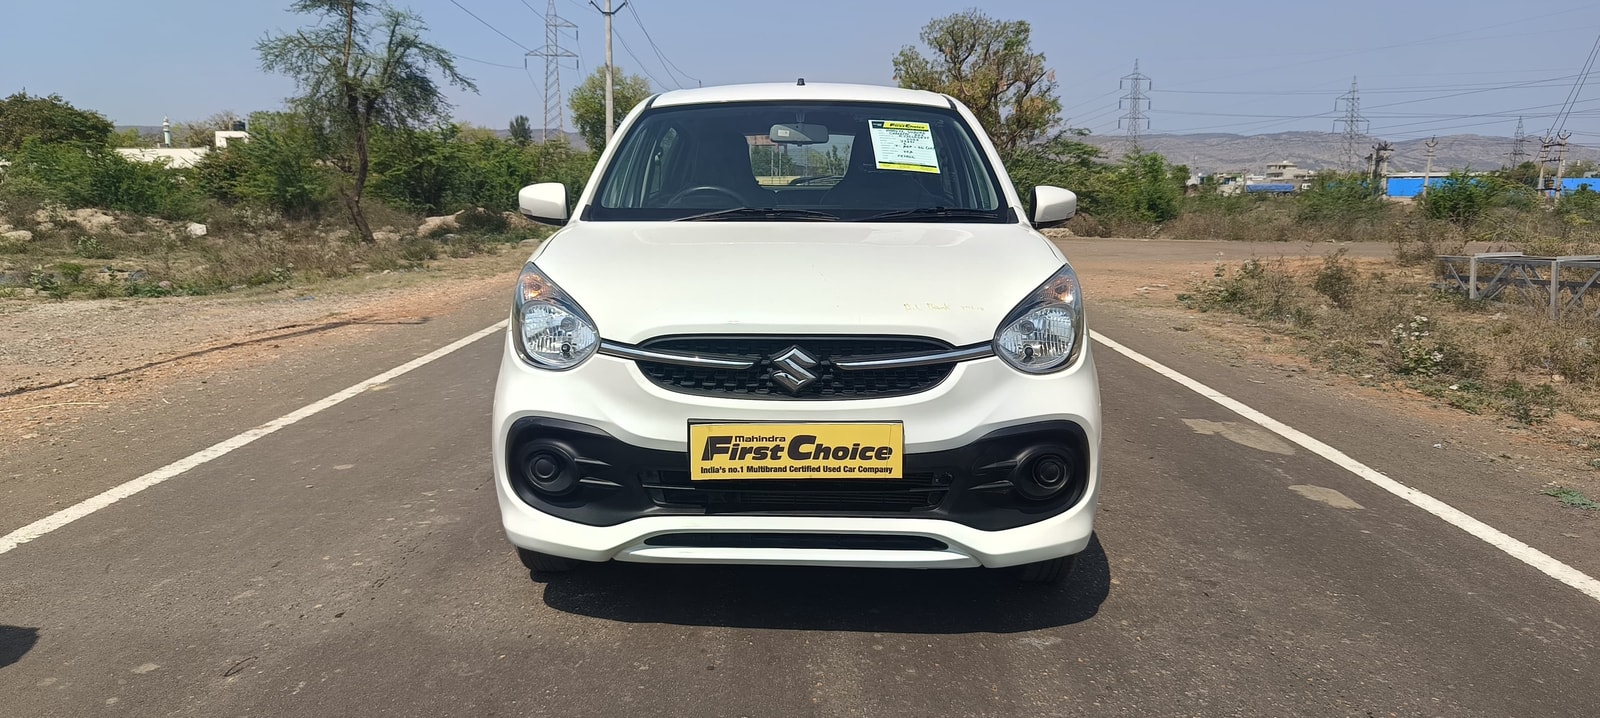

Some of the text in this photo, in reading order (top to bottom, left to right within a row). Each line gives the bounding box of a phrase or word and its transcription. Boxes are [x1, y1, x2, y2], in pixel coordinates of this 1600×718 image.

[734, 435, 786, 443] Mahindra
[701, 434, 893, 461] First Choice
[701, 466, 726, 474] India's
[746, 465, 788, 473] Multibrand
[789, 465, 821, 473] Certified
[822, 465, 841, 473] Used
[843, 465, 857, 473] Car
[857, 465, 893, 475] Company
